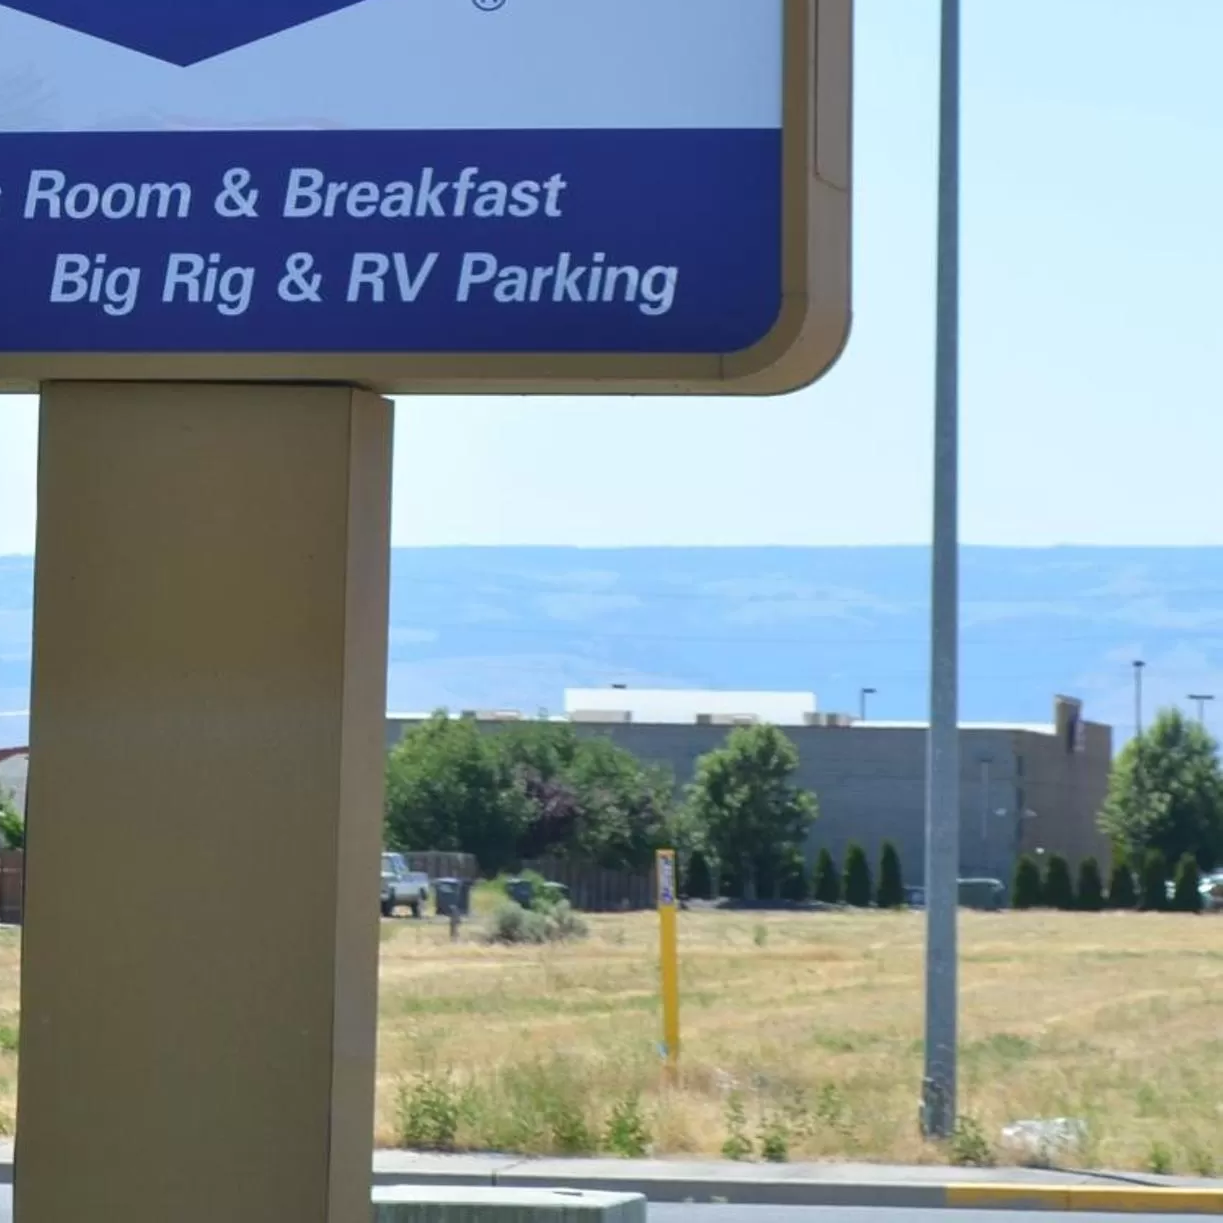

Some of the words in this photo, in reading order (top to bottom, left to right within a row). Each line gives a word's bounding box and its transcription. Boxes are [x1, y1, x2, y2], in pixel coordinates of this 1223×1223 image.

[24, 170, 192, 219] Room
[215, 168, 258, 217] &
[284, 166, 566, 217] Breakfast
[51, 254, 140, 316] Big
[163, 253, 254, 316] Rig
[278, 252, 321, 302] &
[347, 253, 438, 302] RV
[458, 252, 678, 316] Parking
